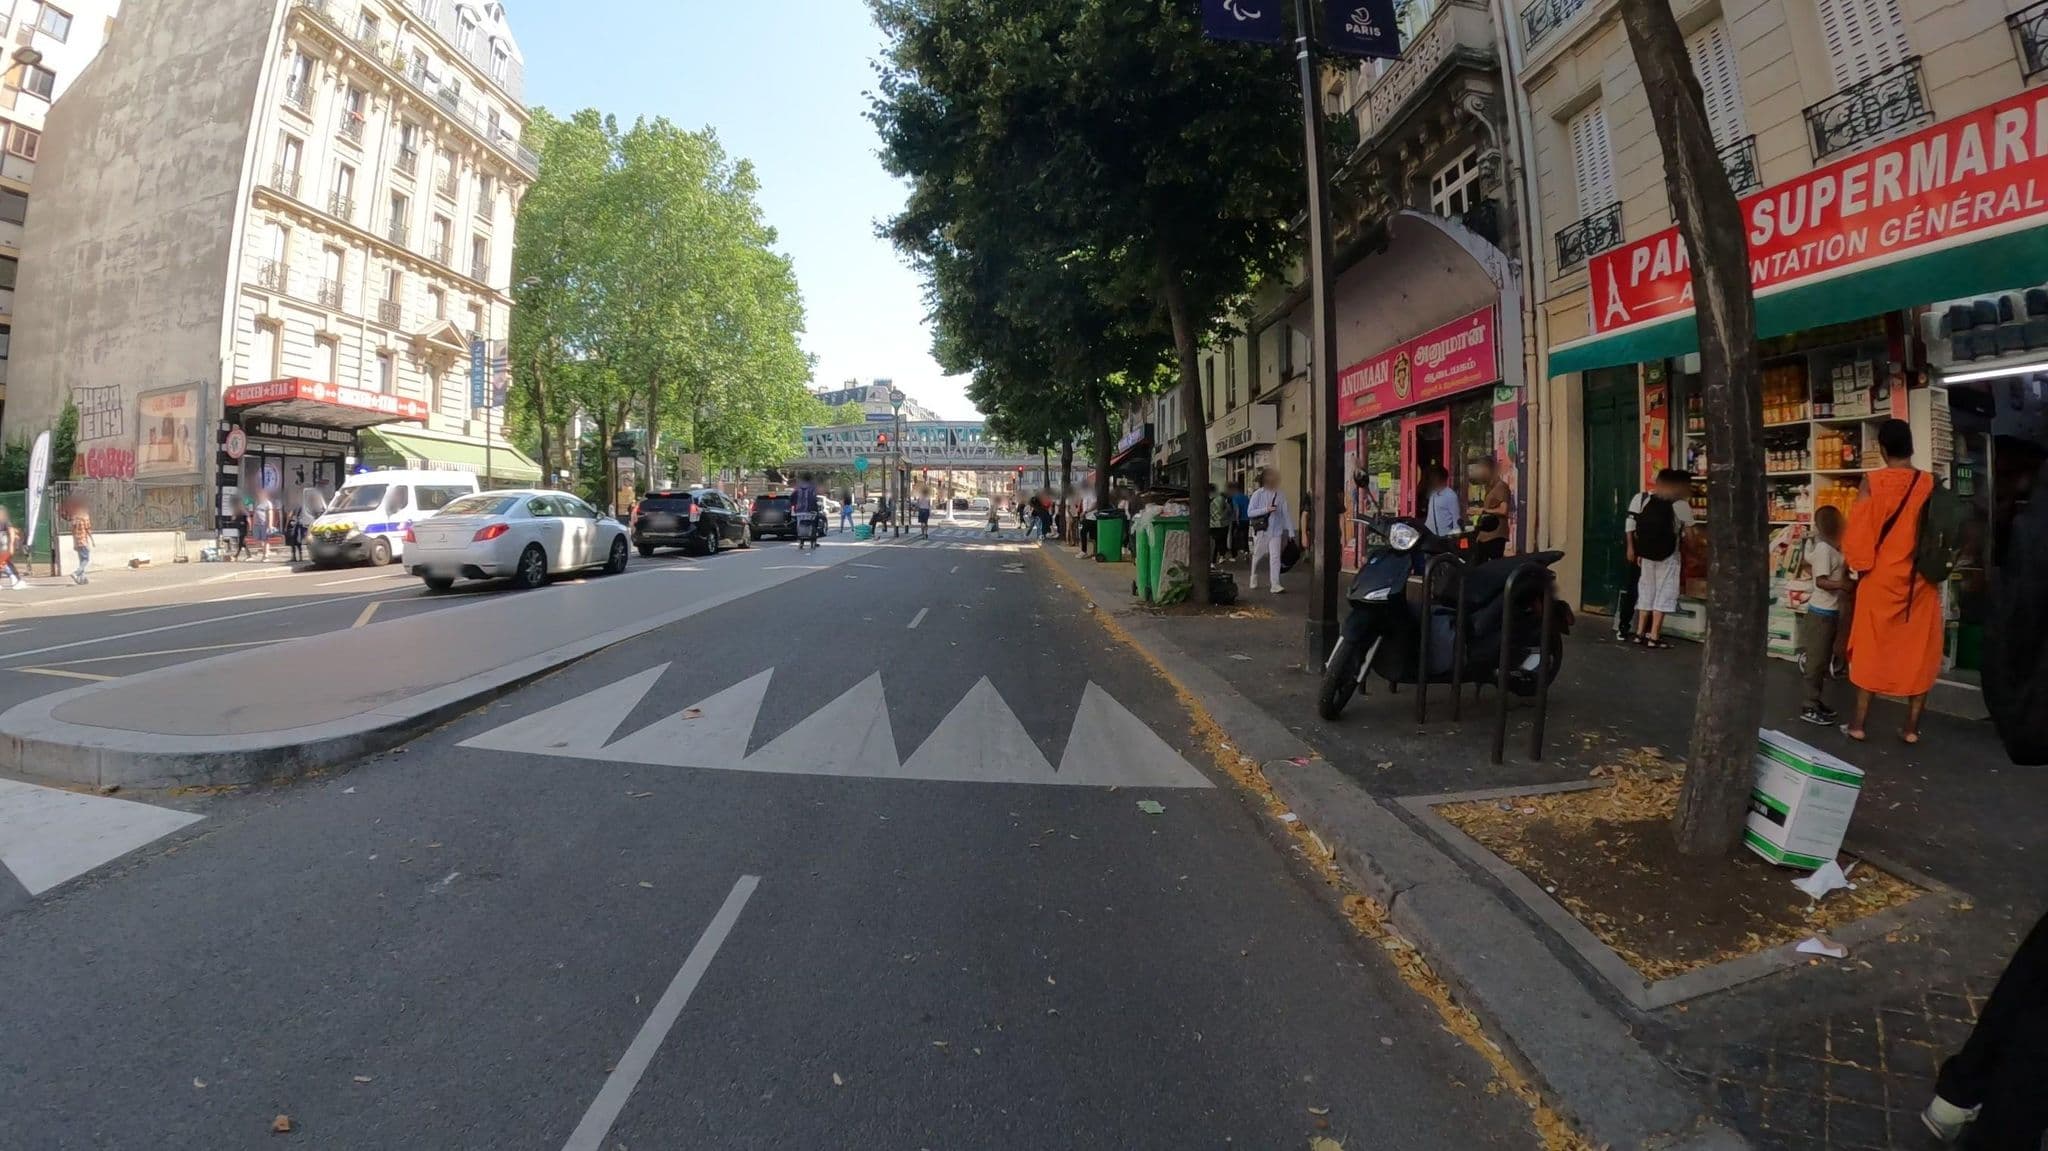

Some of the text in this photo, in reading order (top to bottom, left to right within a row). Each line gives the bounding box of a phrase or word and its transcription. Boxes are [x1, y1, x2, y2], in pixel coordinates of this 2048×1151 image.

[1345, 23, 1381, 37] PARIS
[1341, 359, 1389, 397] ANUMAAN
[236, 382, 289, 400] CHICKEN STAR
[260, 423, 278, 435] NAAN
[282, 425, 298, 437] FRIED
[300, 427, 323, 439] CHICKEN
